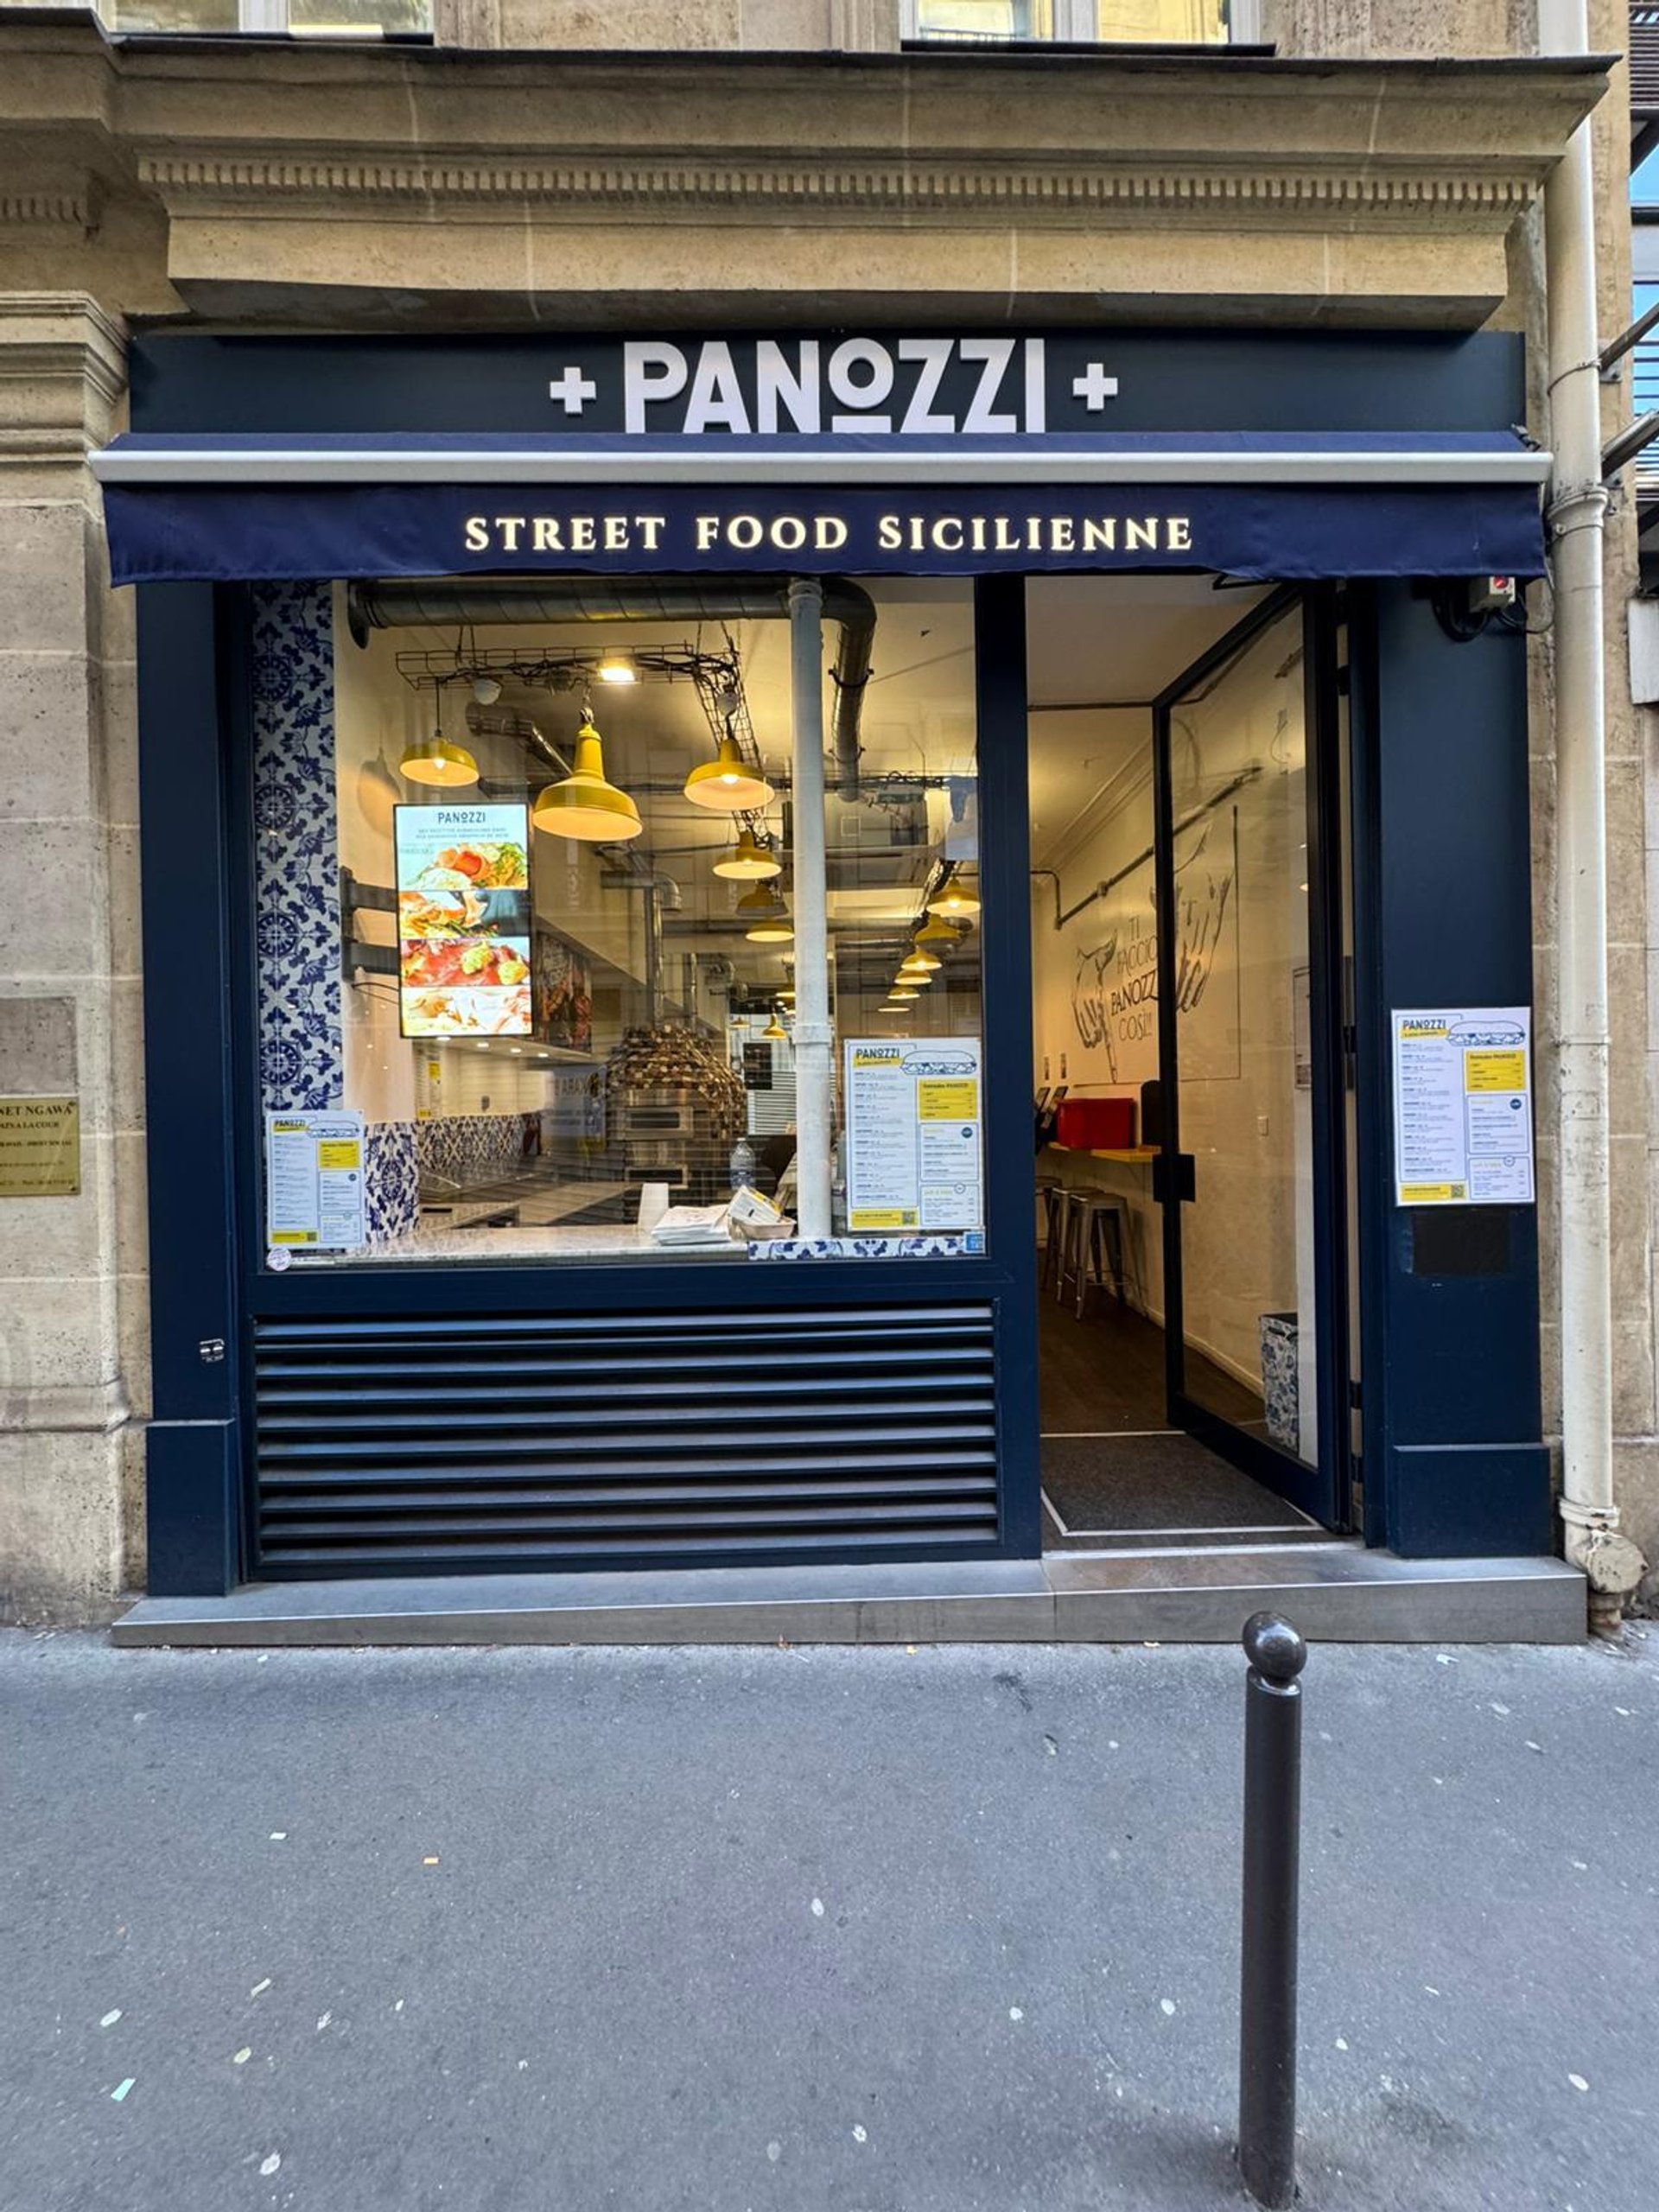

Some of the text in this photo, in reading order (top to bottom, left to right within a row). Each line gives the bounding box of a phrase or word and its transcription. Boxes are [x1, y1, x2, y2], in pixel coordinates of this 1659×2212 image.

[623, 338, 1046, 433] PANOZZI
[465, 516, 1192, 550] STREET FOOD SICILIENNE
[437, 811, 486, 823] PANOZZI
[1111, 969, 1159, 1016] PANOZZ
[1403, 1020, 1446, 1030] PANOZZI
[856, 1048, 900, 1058] PANOZZI
